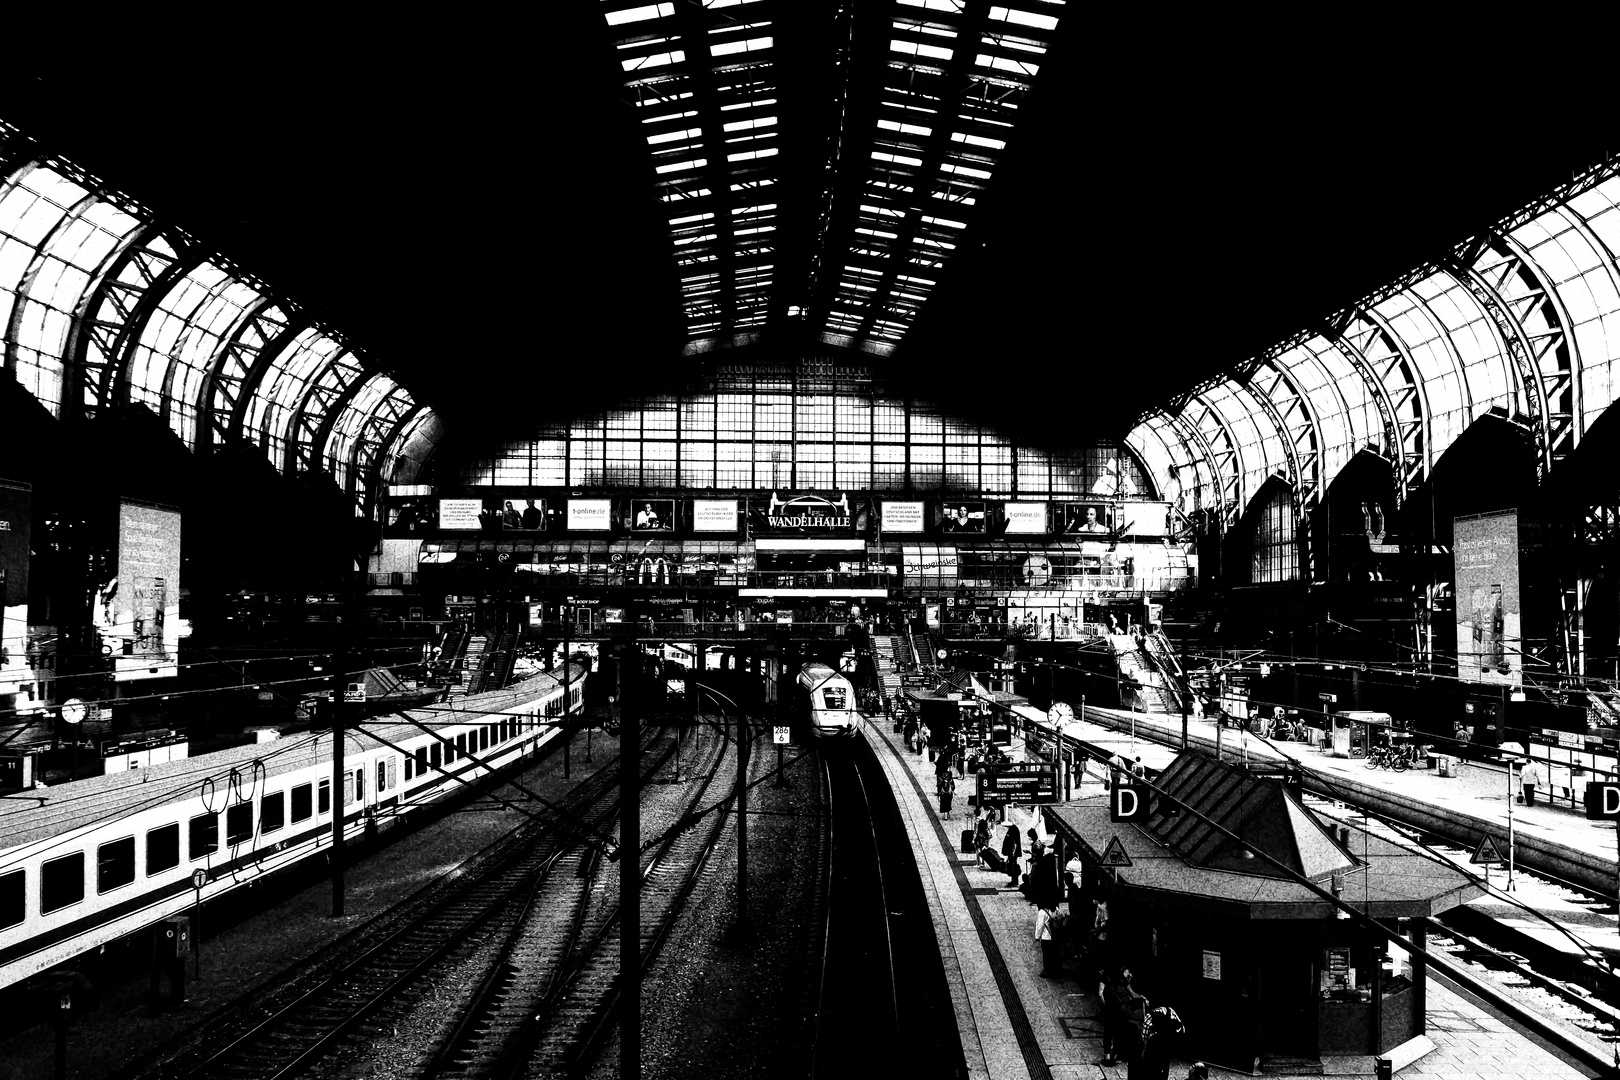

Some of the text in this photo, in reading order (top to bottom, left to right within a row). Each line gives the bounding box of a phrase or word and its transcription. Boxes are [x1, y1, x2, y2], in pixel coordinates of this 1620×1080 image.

[768, 516, 851, 527] WANDELHALLE
[775, 726, 788, 734] 286
[779, 734, 784, 742] 6
[983, 779, 988, 787] 8
[1288, 775, 1293, 784] 7
[1118, 789, 1139, 816] D
